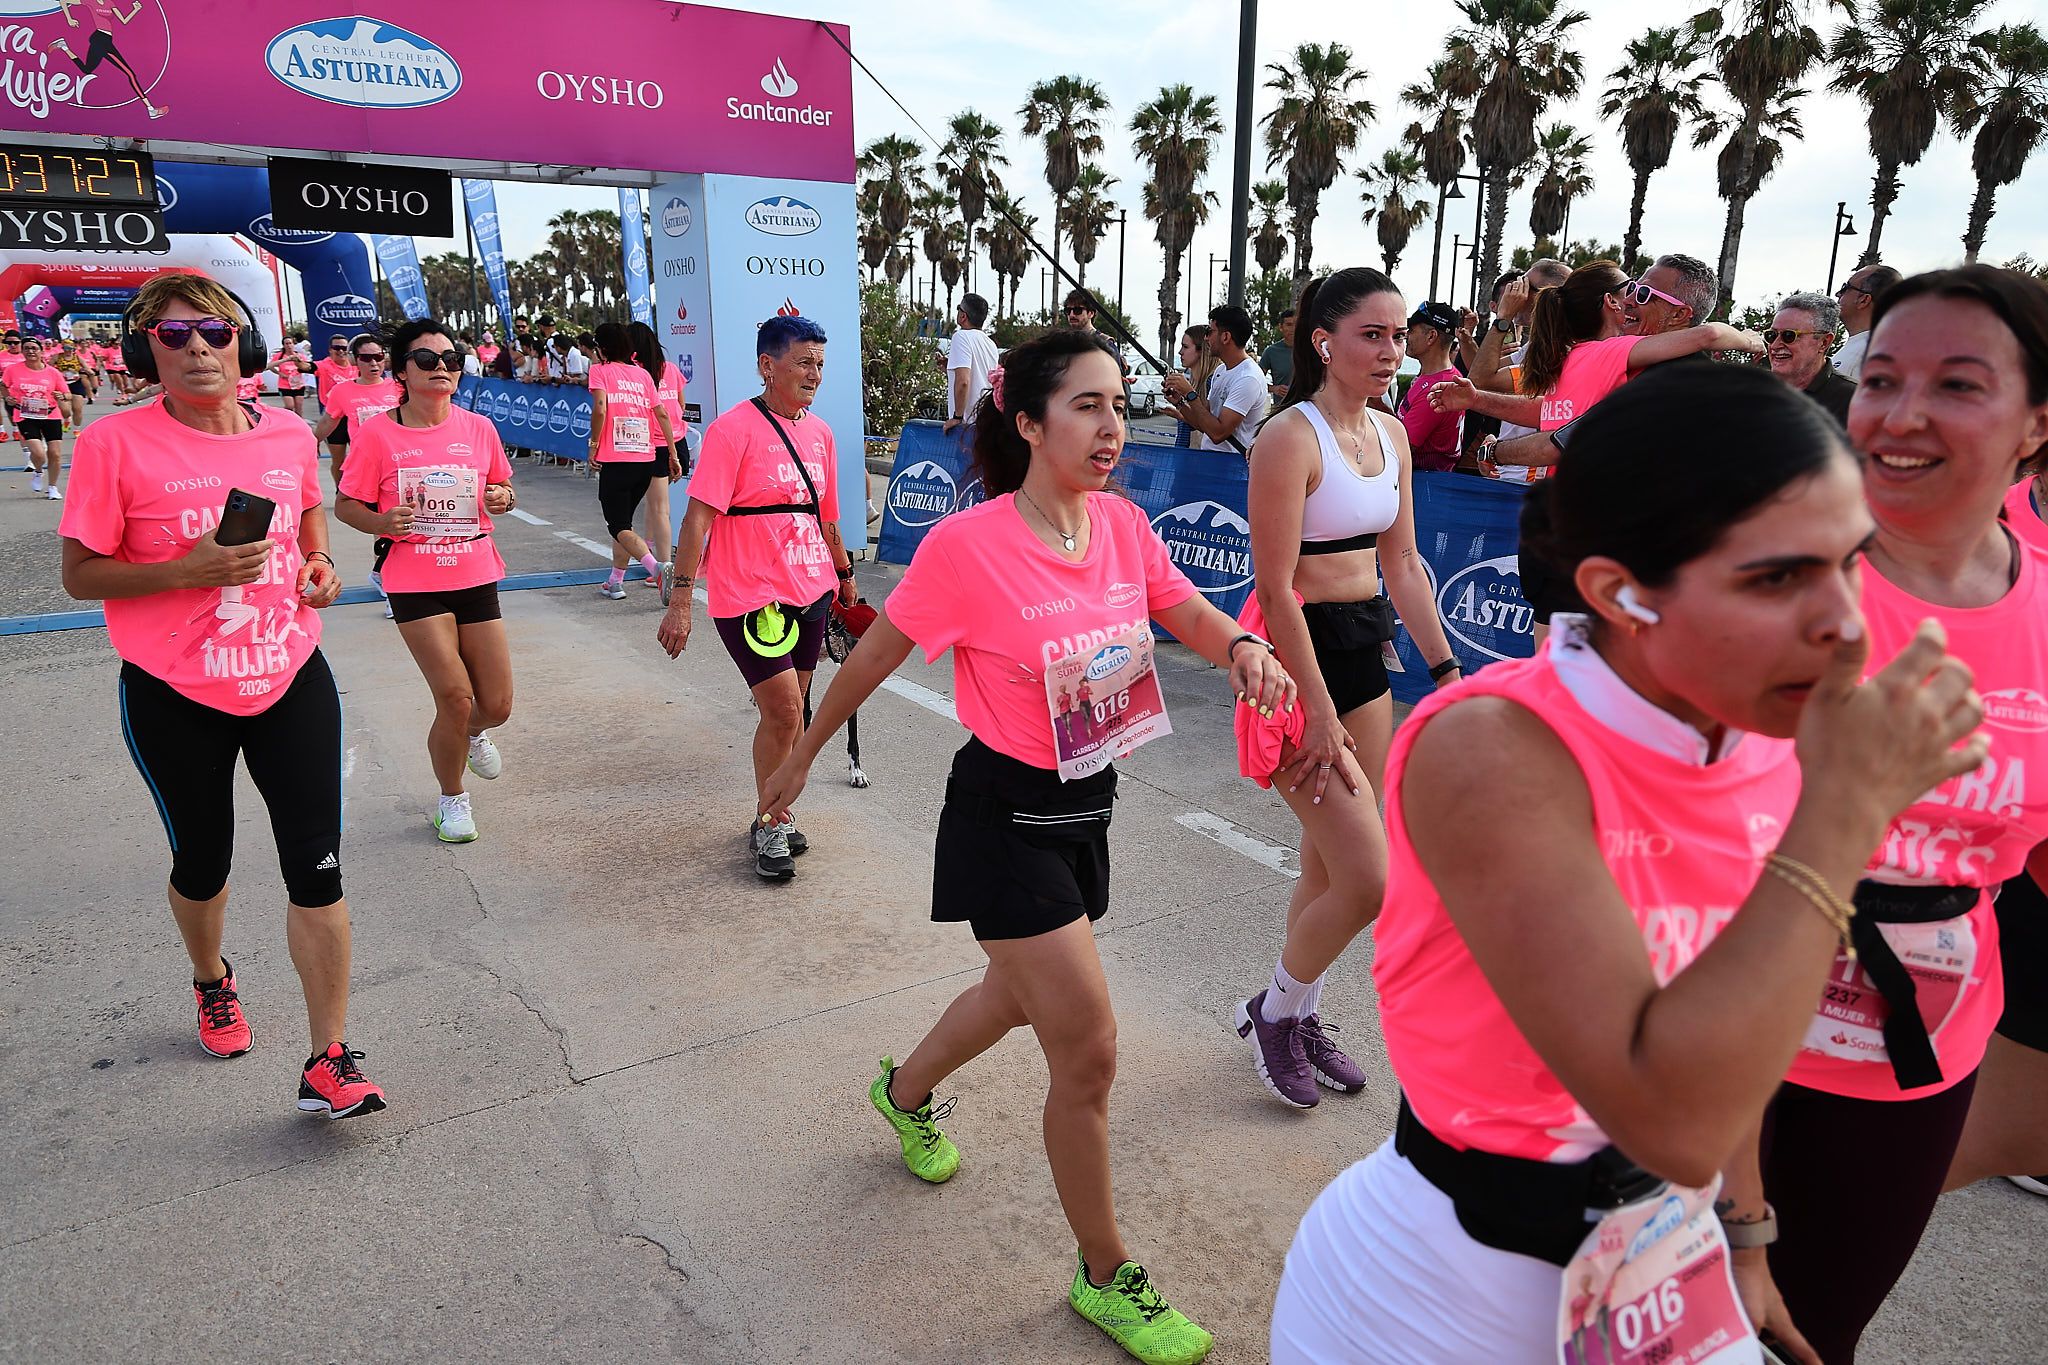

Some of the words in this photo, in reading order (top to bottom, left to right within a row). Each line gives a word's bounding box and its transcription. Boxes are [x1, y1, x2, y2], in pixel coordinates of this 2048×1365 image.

[312, 44, 374, 57] CENTRAL
[381, 51, 440, 64] LECHERA
[284, 44, 449, 89] ASTURIANA
[537, 71, 664, 109] OYSHO
[727, 98, 833, 126] Santander
[302, 183, 429, 216] OYSHO
[0, 210, 156, 246] YSHO
[664, 213, 690, 229] ASTURIANA
[751, 209, 816, 227] ASTURIANA
[211, 259, 250, 267] OYSHO
[664, 256, 696, 277] OYSHO
[746, 256, 825, 276] OYSHO
[252, 307, 273, 315] SHO
[671, 323, 697, 335] Santander
[391, 448, 423, 462] OYSHO
[165, 475, 222, 494] OYSHO
[904, 482, 924, 490] CENTRAL
[925, 484, 950, 493] LECHERA
[427, 499, 456, 511] 016
[892, 482, 947, 513] ASTURIANA
[1169, 526, 1207, 541] CENTRAL
[1211, 533, 1252, 549] LECHERA
[436, 556, 458, 567] 2026
[787, 543, 830, 566] MUJER
[1021, 597, 1076, 621] OYSHO
[1448, 580, 1534, 636] ASTU
[204, 644, 290, 679] MUJER
[1057, 665, 1083, 679] SUMA
[1089, 653, 1130, 677] ASTURIANA
[238, 678, 271, 696] 2026
[1094, 689, 1130, 723] 016
[1072, 740, 1100, 757] CARRERA
[1075, 749, 1107, 772] OYSHO
[1123, 724, 1155, 745] Santander
[1824, 1003, 1866, 1025] MUJER
[1615, 1277, 1685, 1351] 016
